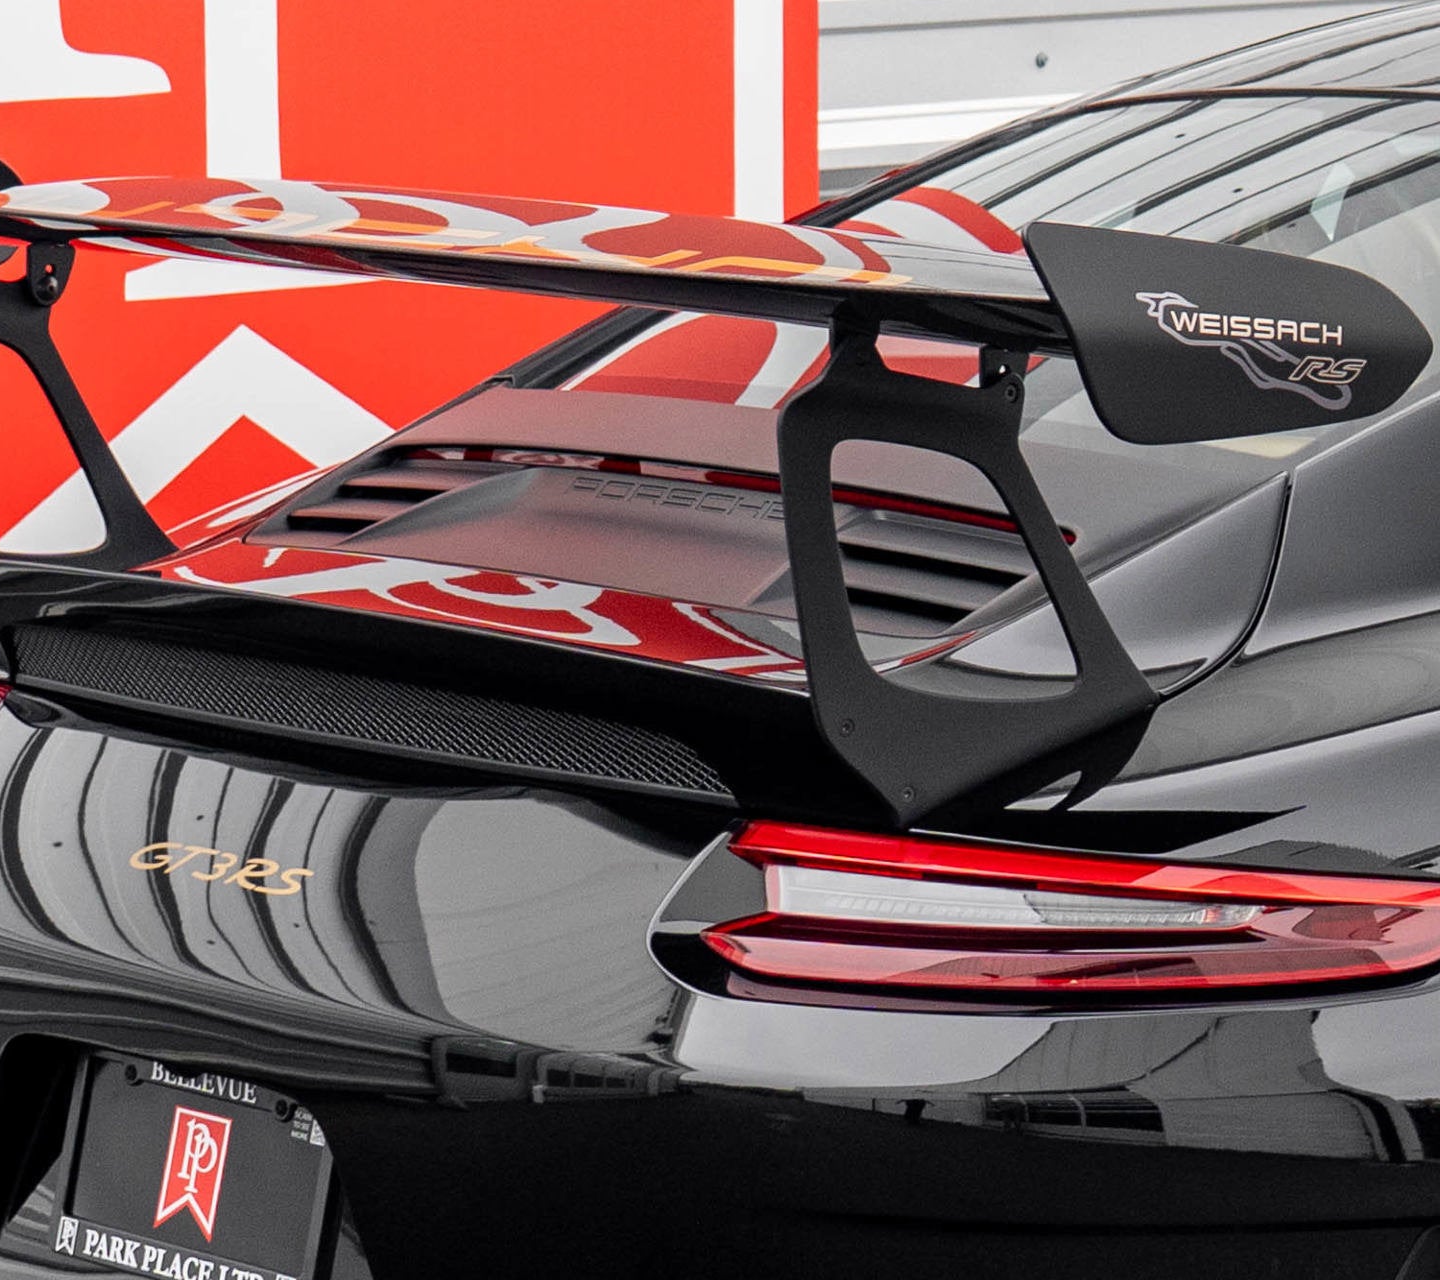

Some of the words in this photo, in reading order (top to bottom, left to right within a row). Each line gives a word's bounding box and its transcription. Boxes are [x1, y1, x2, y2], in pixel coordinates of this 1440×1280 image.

[1169, 309, 1343, 346] WEISSACH
[1288, 355, 1368, 385] RS
[83, 1228, 141, 1272] PARK
